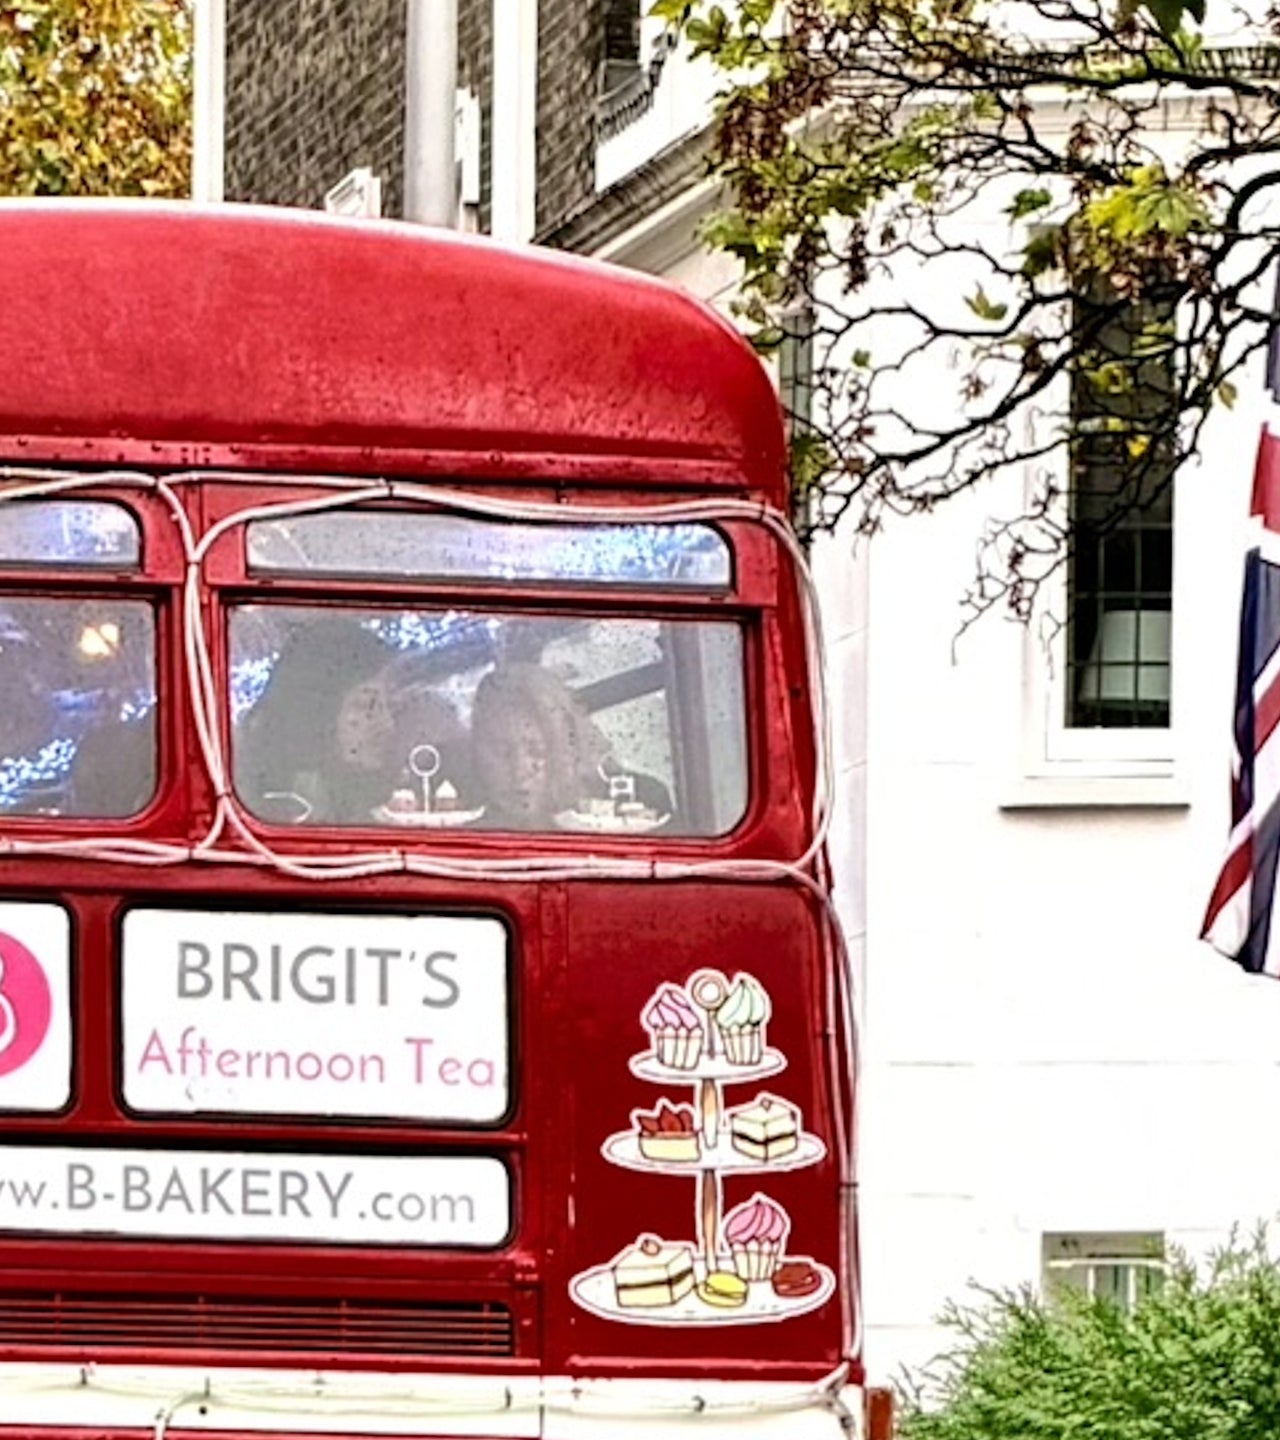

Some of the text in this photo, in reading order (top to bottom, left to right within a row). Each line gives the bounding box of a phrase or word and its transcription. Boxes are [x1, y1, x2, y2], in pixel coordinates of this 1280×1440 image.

[176, 940, 461, 1010] BRIGIT'S
[138, 1025, 495, 1088] Afternoon Tea
